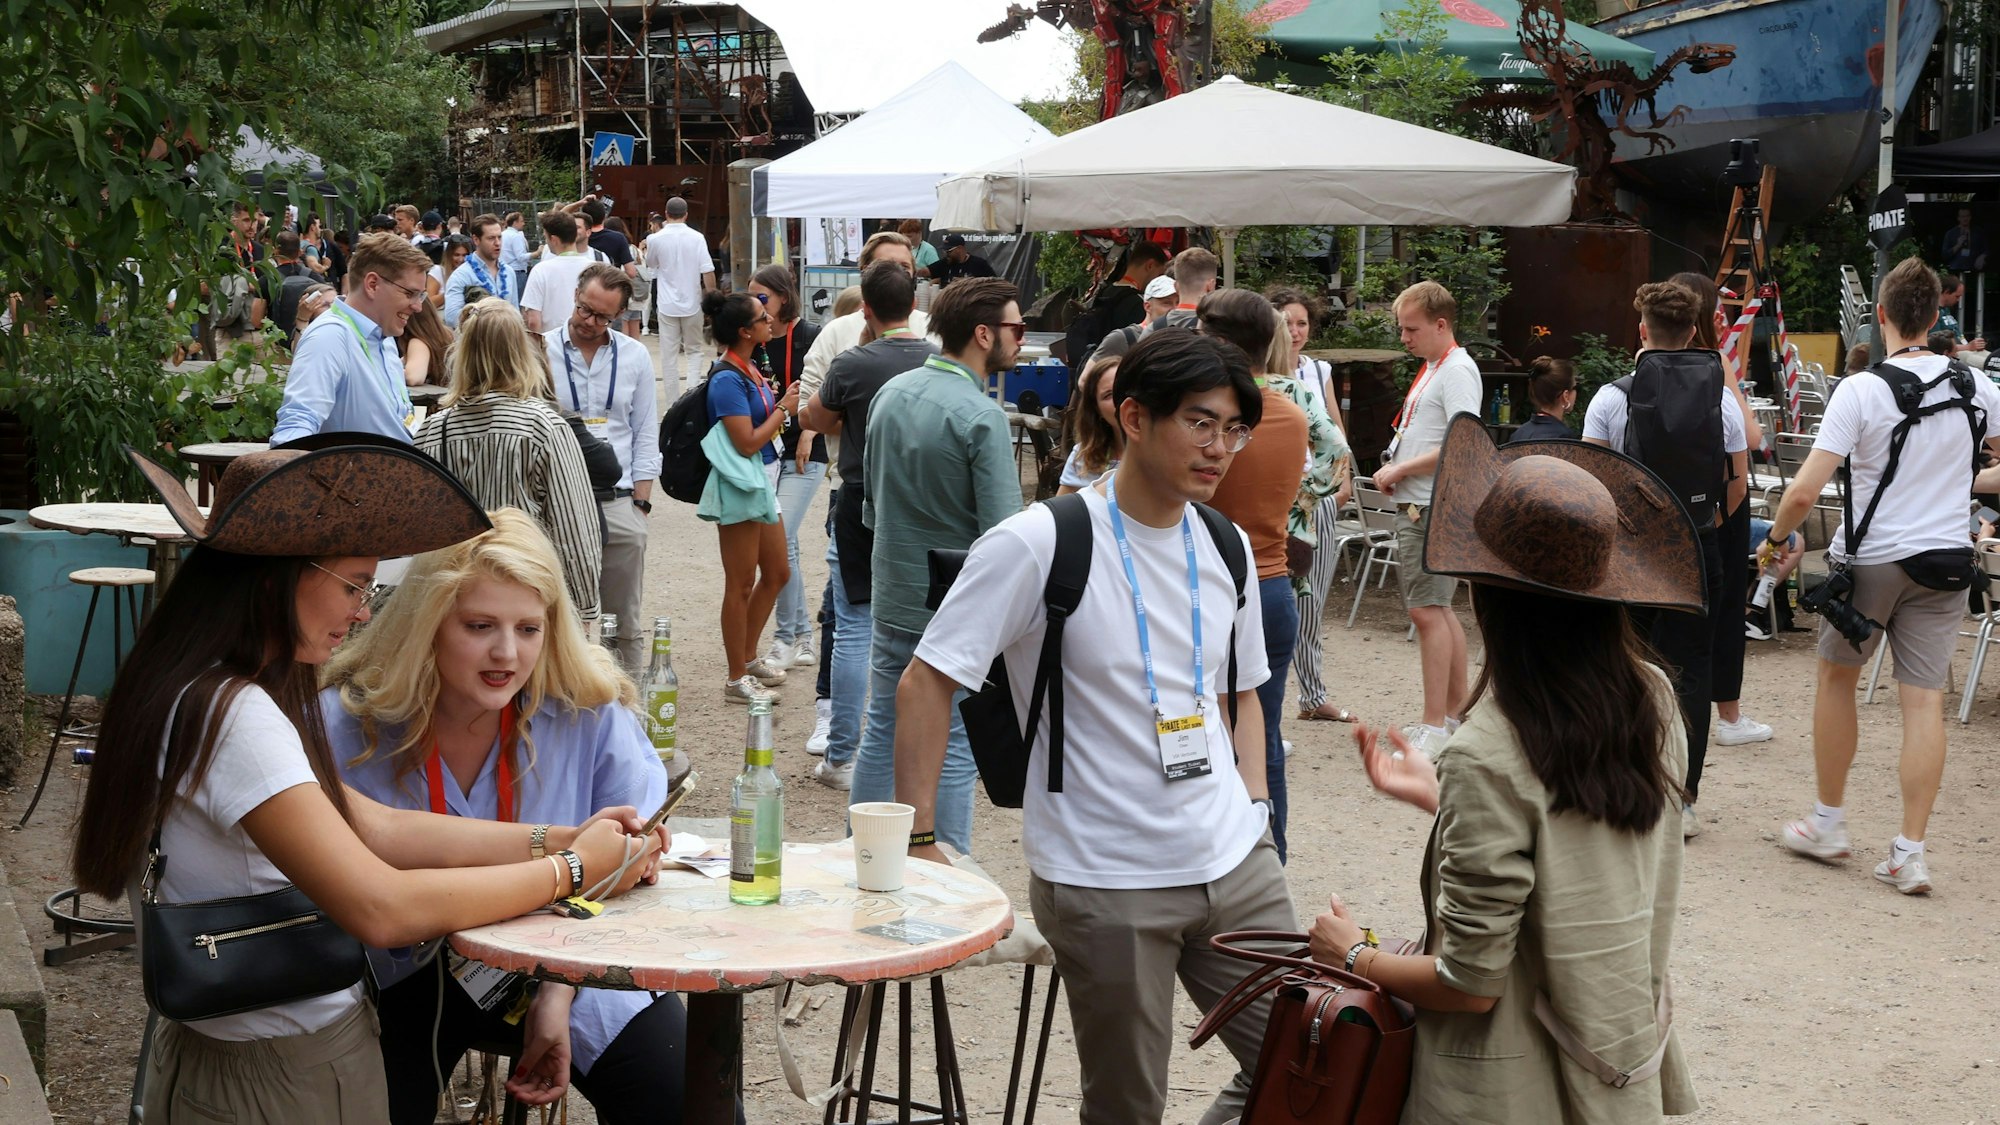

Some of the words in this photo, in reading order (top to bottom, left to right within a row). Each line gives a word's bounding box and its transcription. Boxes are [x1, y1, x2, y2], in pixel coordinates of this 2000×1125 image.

[1499, 53, 1538, 73] Tanqu
[1868, 208, 1905, 232] PIRATE
[1191, 588, 1200, 609] PIRATE
[1160, 720, 1180, 731] PIRATE
[564, 853, 582, 883] PIRATE
